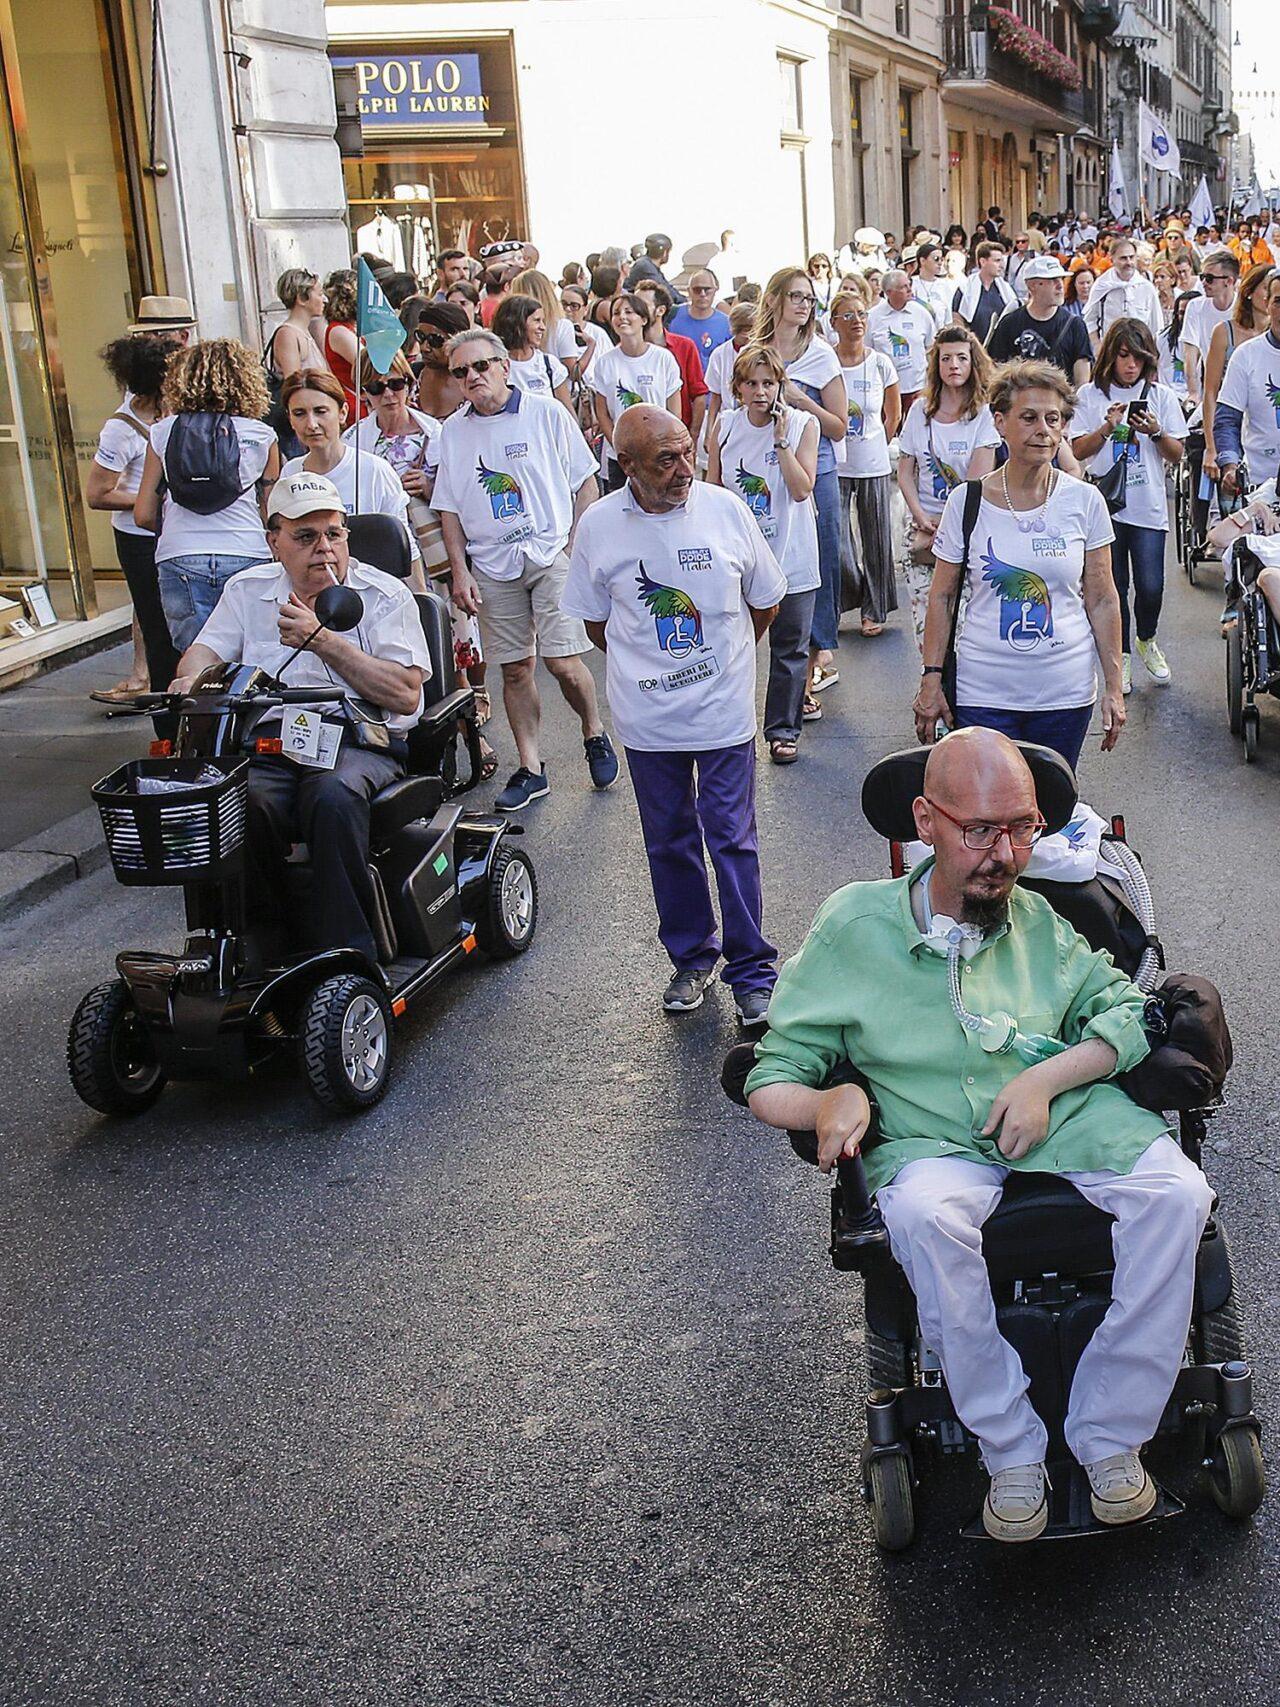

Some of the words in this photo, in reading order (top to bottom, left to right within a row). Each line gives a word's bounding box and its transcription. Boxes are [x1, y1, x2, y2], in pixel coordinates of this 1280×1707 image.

[355, 60, 461, 94] POLO
[360, 97, 398, 113] LPH
[409, 95, 490, 112] LAUREN
[290, 482, 328, 494] FIABA
[680, 553, 711, 563] PRIDE
[682, 560, 712, 571] Italia
[667, 667, 696, 682] LIBERI
[697, 662, 708, 671] DI
[669, 669, 714, 688] SCEGLIERE
